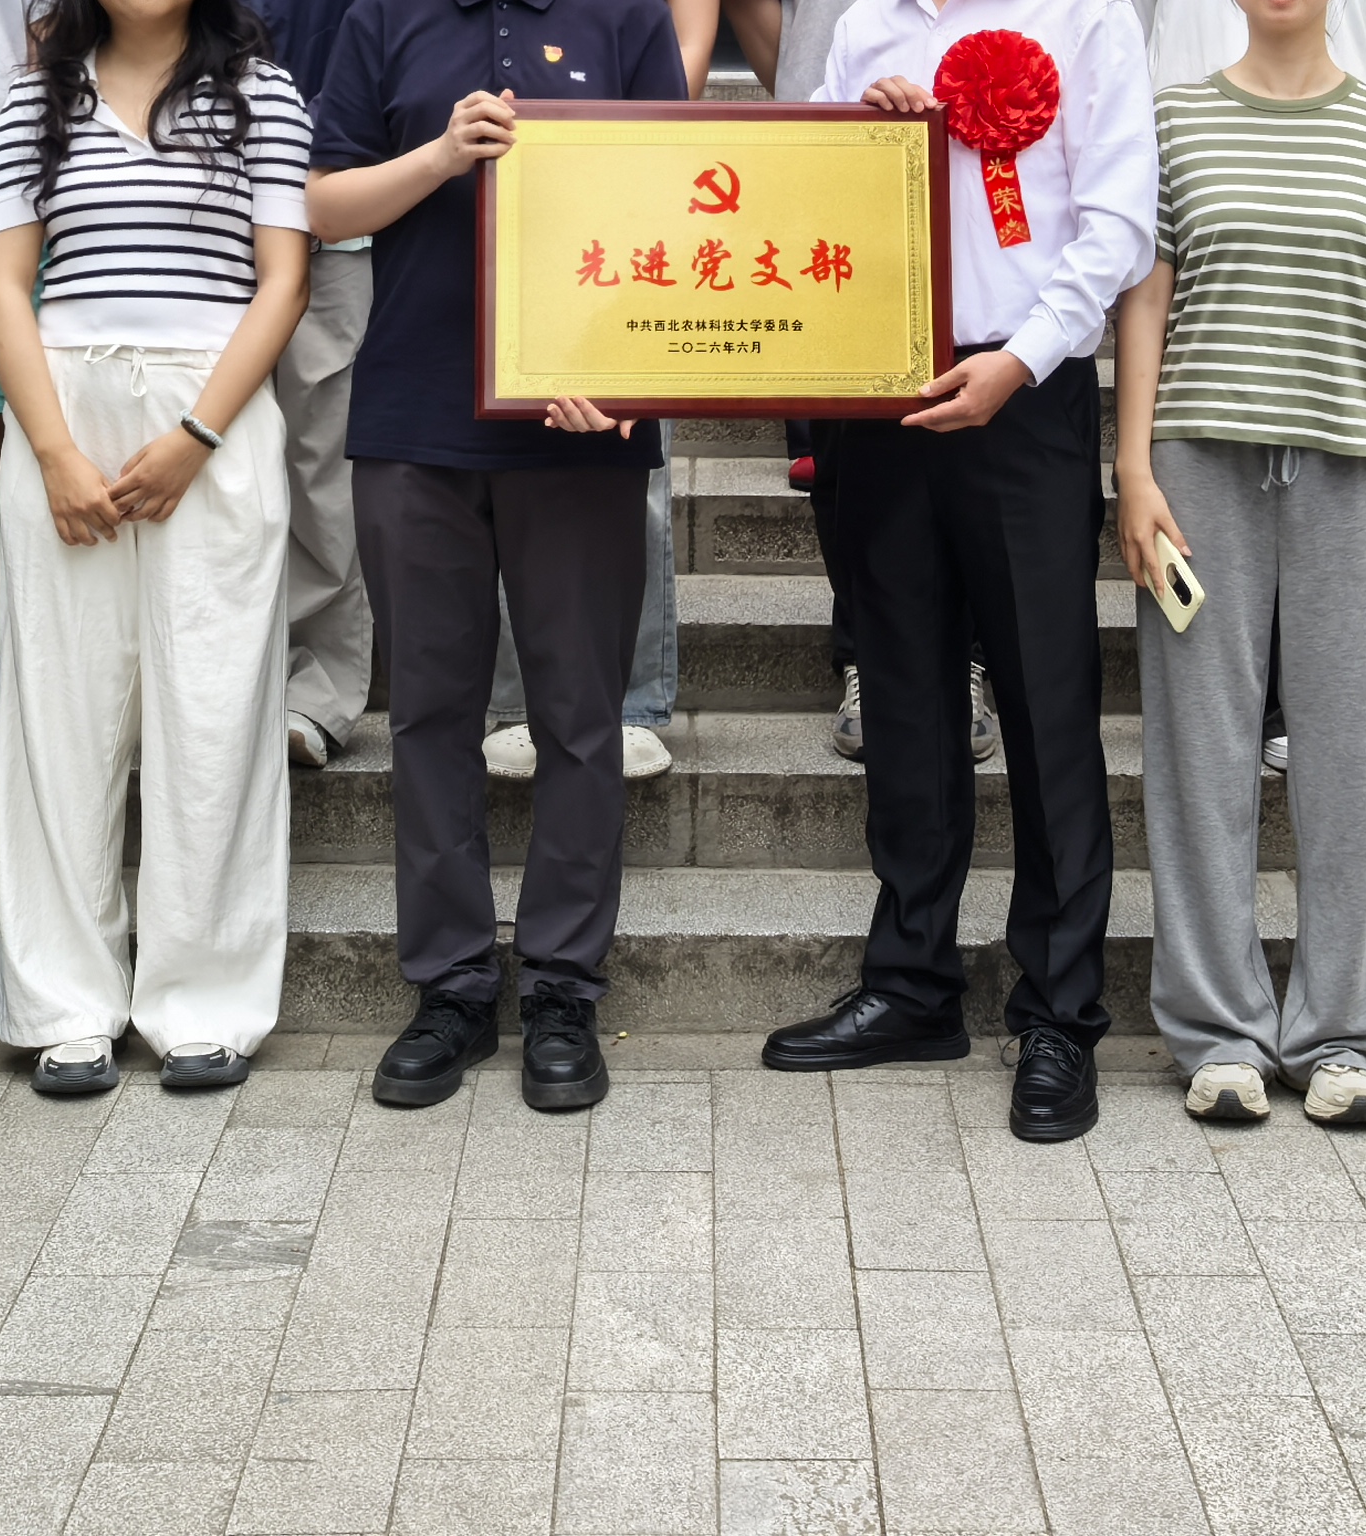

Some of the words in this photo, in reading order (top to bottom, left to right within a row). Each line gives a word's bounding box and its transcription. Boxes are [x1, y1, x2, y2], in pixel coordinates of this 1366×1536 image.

[986, 157, 1022, 215] 光荣
[575, 238, 854, 294] 先进党支部
[626, 318, 804, 333] 中共西北农林科技大学委员会
